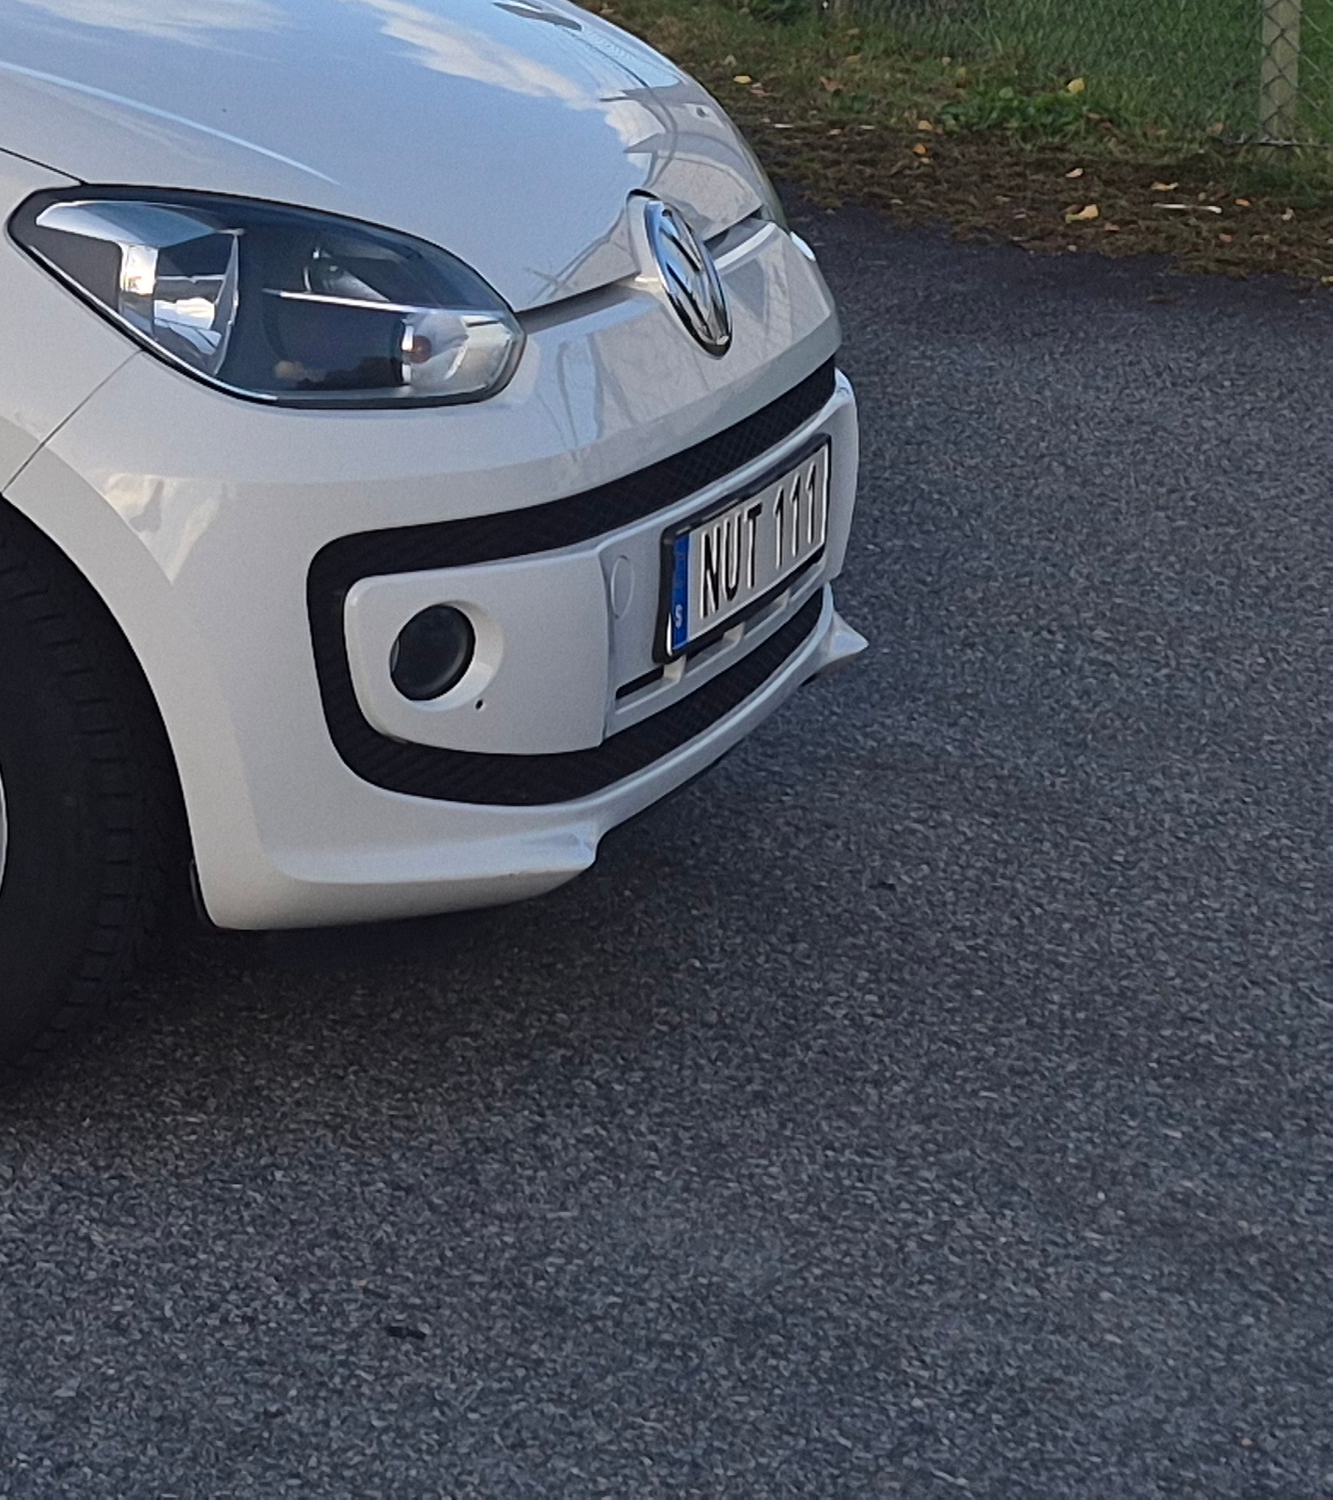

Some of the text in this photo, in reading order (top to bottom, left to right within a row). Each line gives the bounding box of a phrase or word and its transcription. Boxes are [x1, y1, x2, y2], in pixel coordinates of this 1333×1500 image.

[699, 461, 816, 620] NUT 111
[673, 603, 684, 629] S
